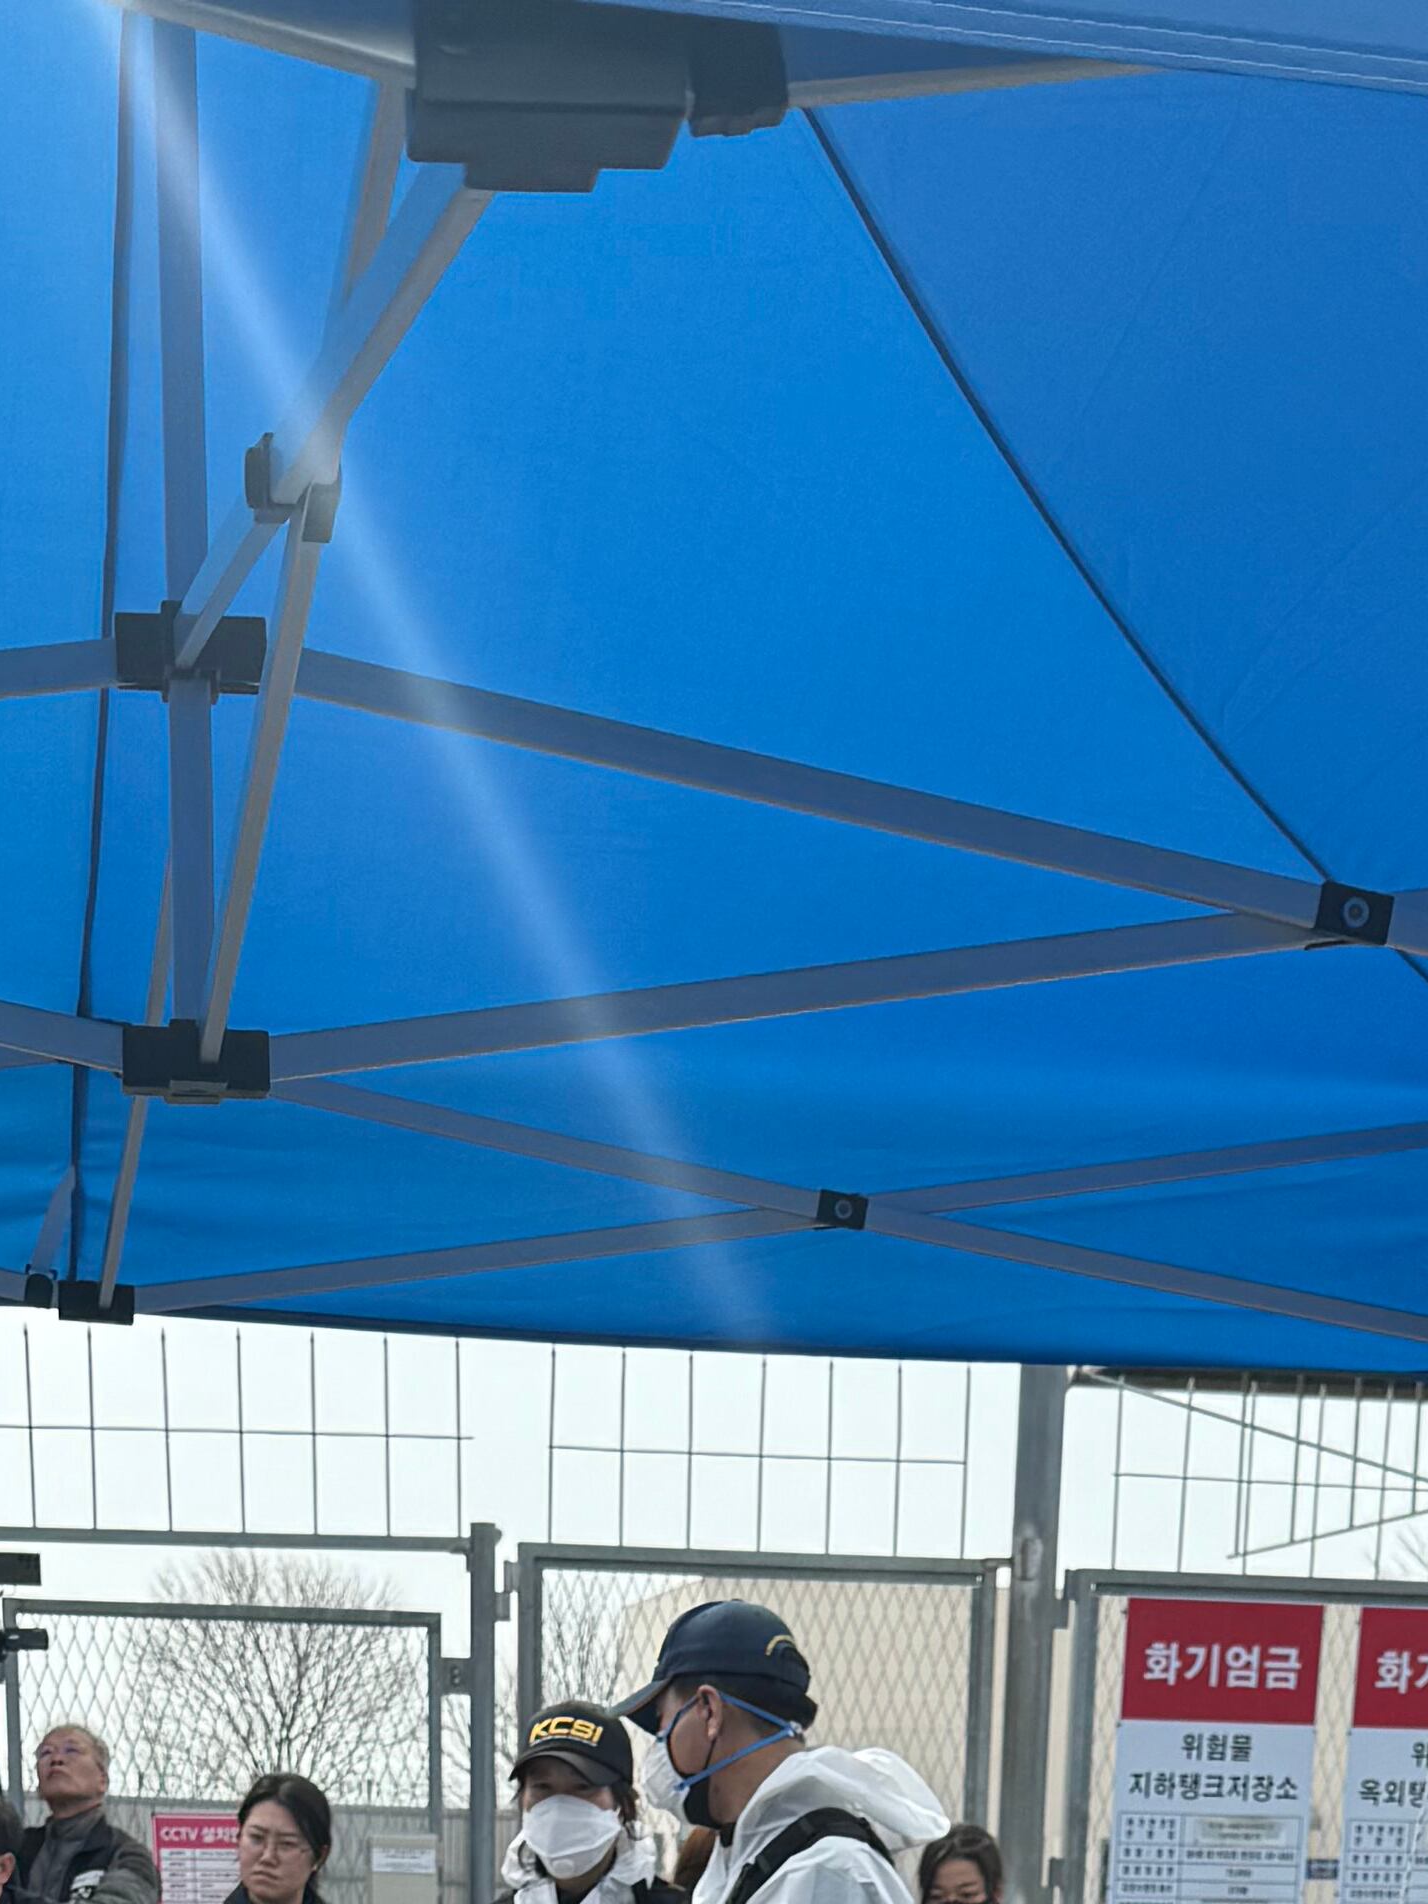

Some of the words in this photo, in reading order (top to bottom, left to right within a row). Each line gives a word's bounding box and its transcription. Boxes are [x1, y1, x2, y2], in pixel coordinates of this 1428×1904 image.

[1143, 1640, 1304, 1690] 화기엄금
[529, 1715, 605, 1745] KCSI
[1181, 1732, 1254, 1764] 위험물
[1127, 1770, 1299, 1803] 지하탱크저장소
[160, 1826, 199, 1842] CCTV
